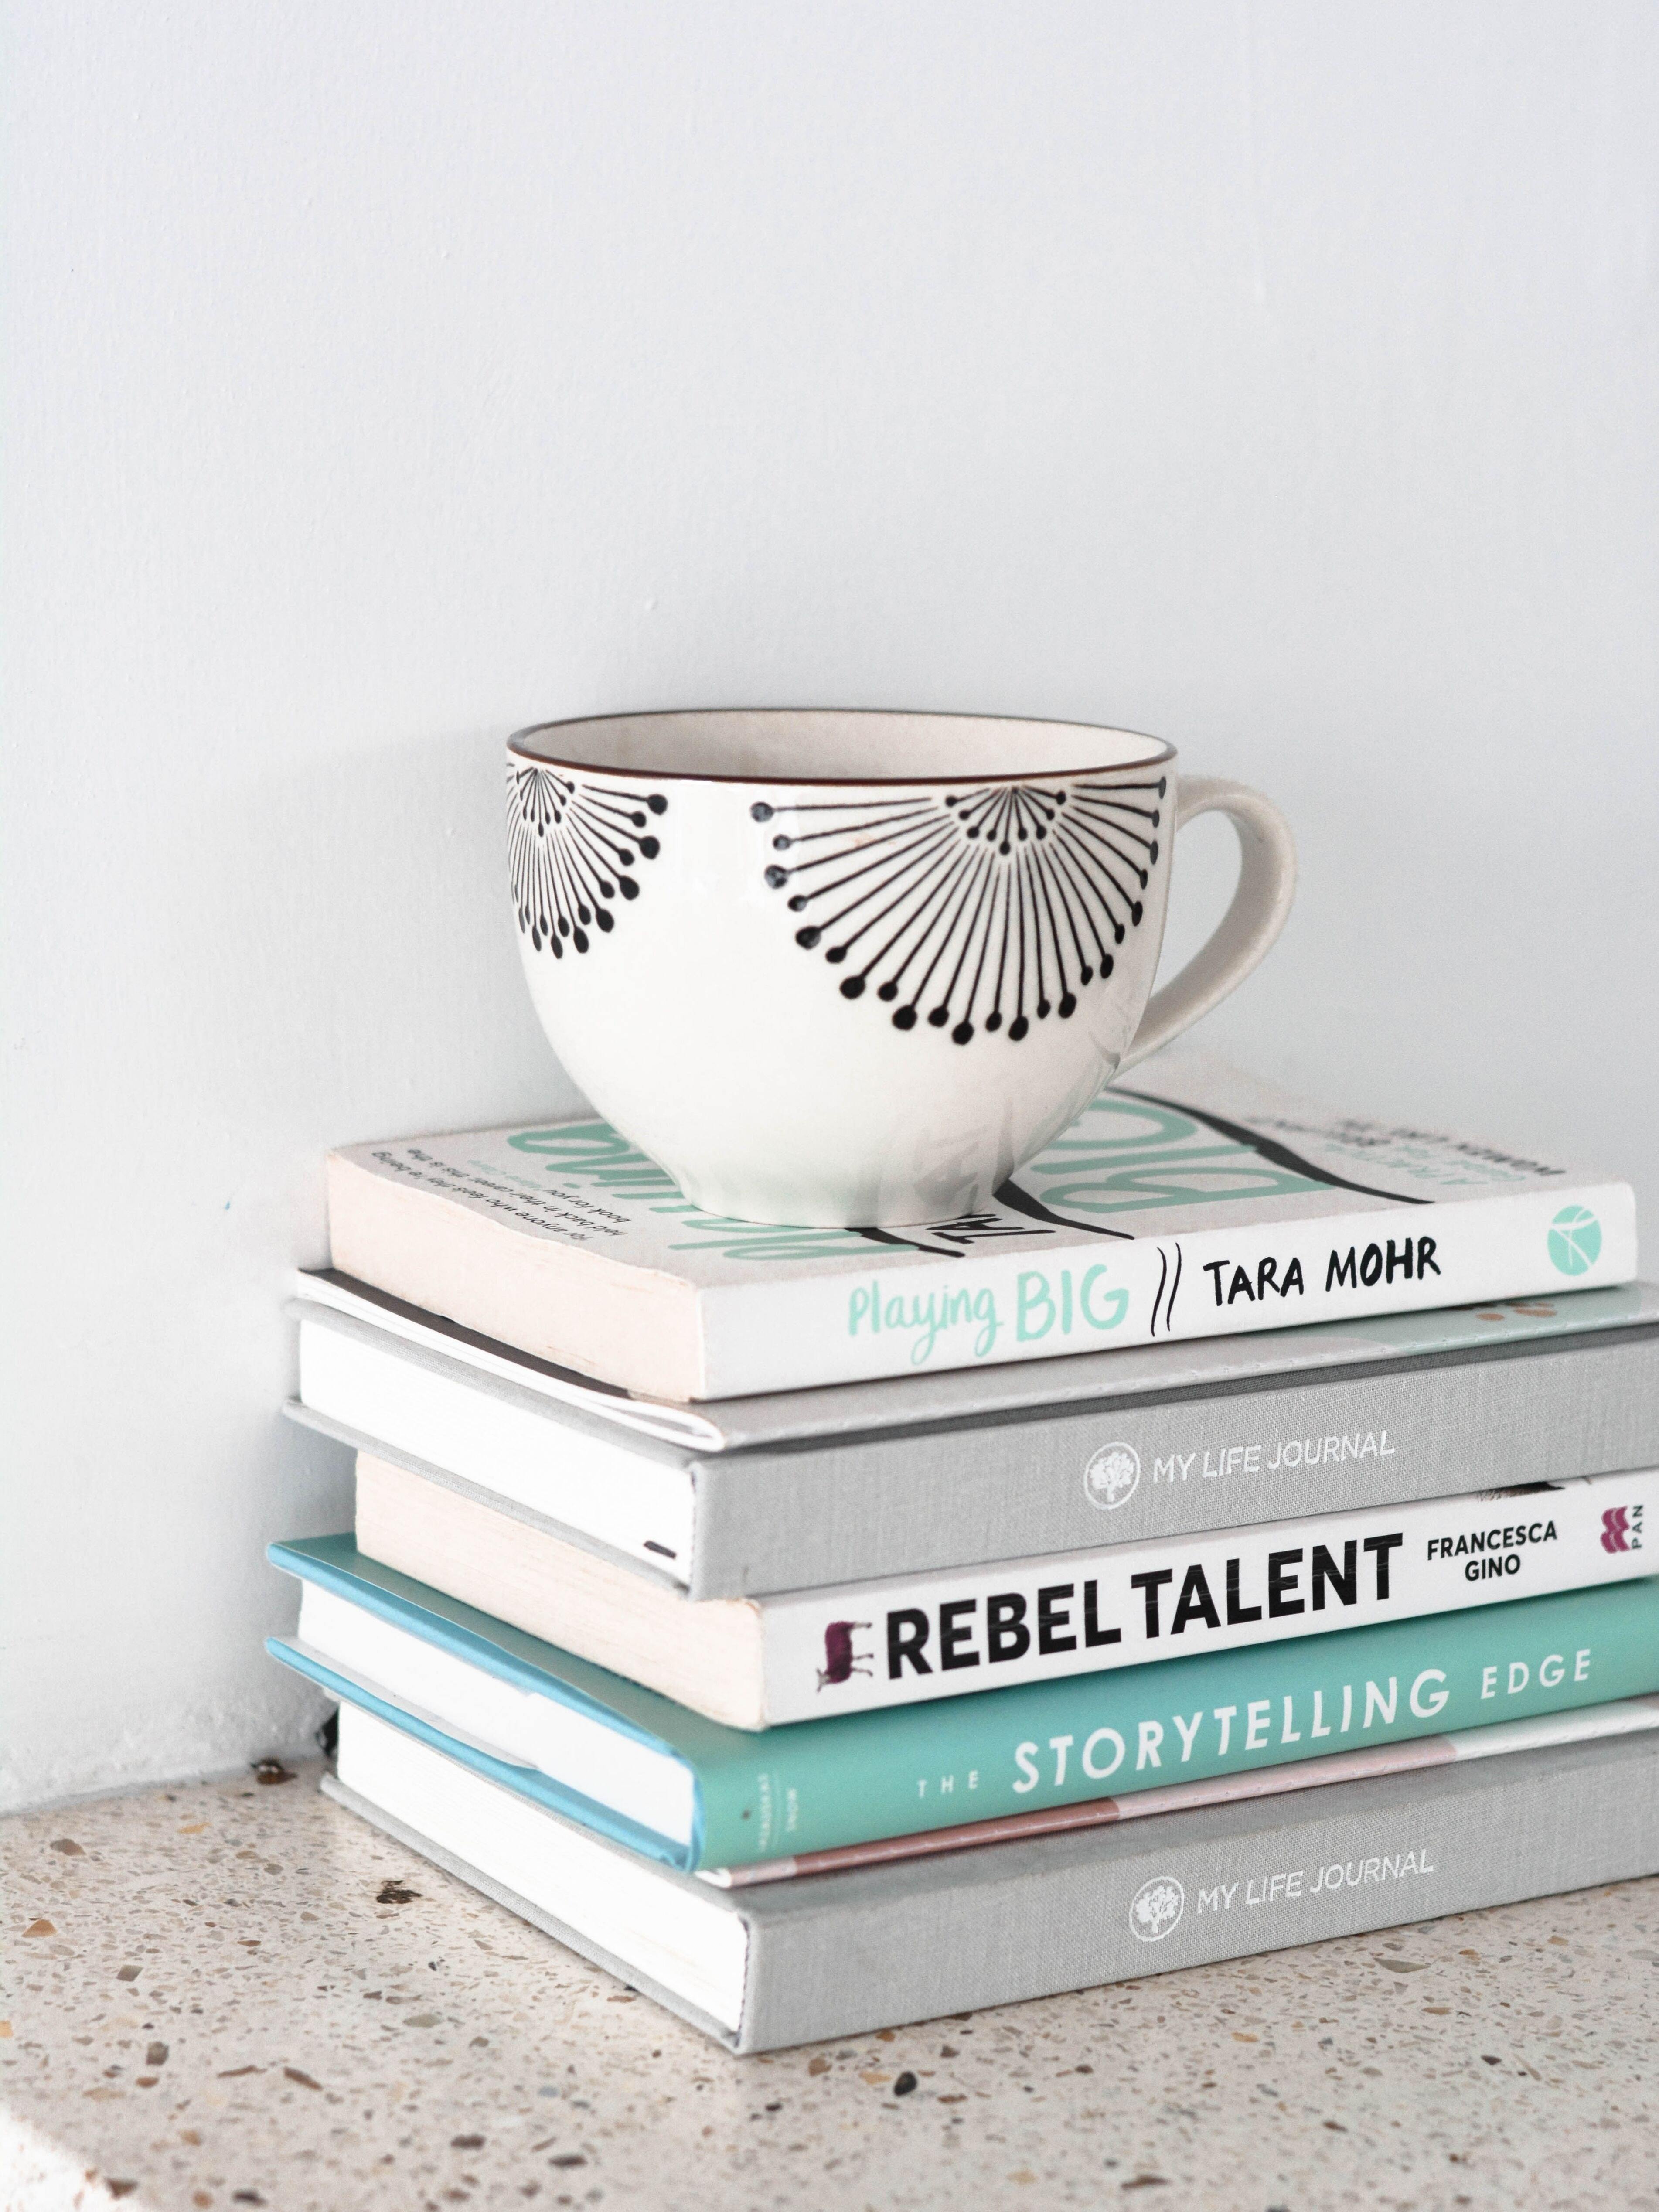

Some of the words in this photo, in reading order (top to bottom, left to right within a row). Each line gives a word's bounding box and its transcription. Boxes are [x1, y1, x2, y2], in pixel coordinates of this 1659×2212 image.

[371, 1152, 412, 1172] being
[407, 1149, 433, 1161] the
[441, 1168, 470, 1178] this
[452, 1187, 490, 1199] feels
[509, 1192, 547, 1205] their
[485, 1199, 518, 1212] who
[567, 1200, 595, 1208] for
[514, 1212, 569, 1232] anyone
[554, 1212, 595, 1226] back
[587, 1208, 631, 1223] book
[584, 1225, 628, 1236] held
[848, 1279, 1004, 1365] Playing
[1015, 1263, 1129, 1343] BIG
[1203, 1256, 1304, 1307] TARA
[1325, 1236, 1441, 1292] MOHR
[1153, 1452, 1196, 1484] MY
[1202, 1444, 1261, 1479] LIFE
[1267, 1430, 1396, 1471] JOURNAL
[1631, 1504, 1645, 1550] PAN
[1427, 1520, 1559, 1561] FRANCESCA
[1465, 1554, 1521, 1581] GINO
[886, 1579, 1122, 1680] REBEL
[1131, 1532, 1404, 1639] TALENT
[917, 1769, 979, 1799] THE
[1012, 1667, 1451, 1795] STORYTELLING
[1479, 1648, 1592, 1700] EDGE
[1196, 1882, 1240, 1915] MY
[1245, 1870, 1304, 1906] LIFE
[1309, 1848, 1434, 1894] JOURNAL
